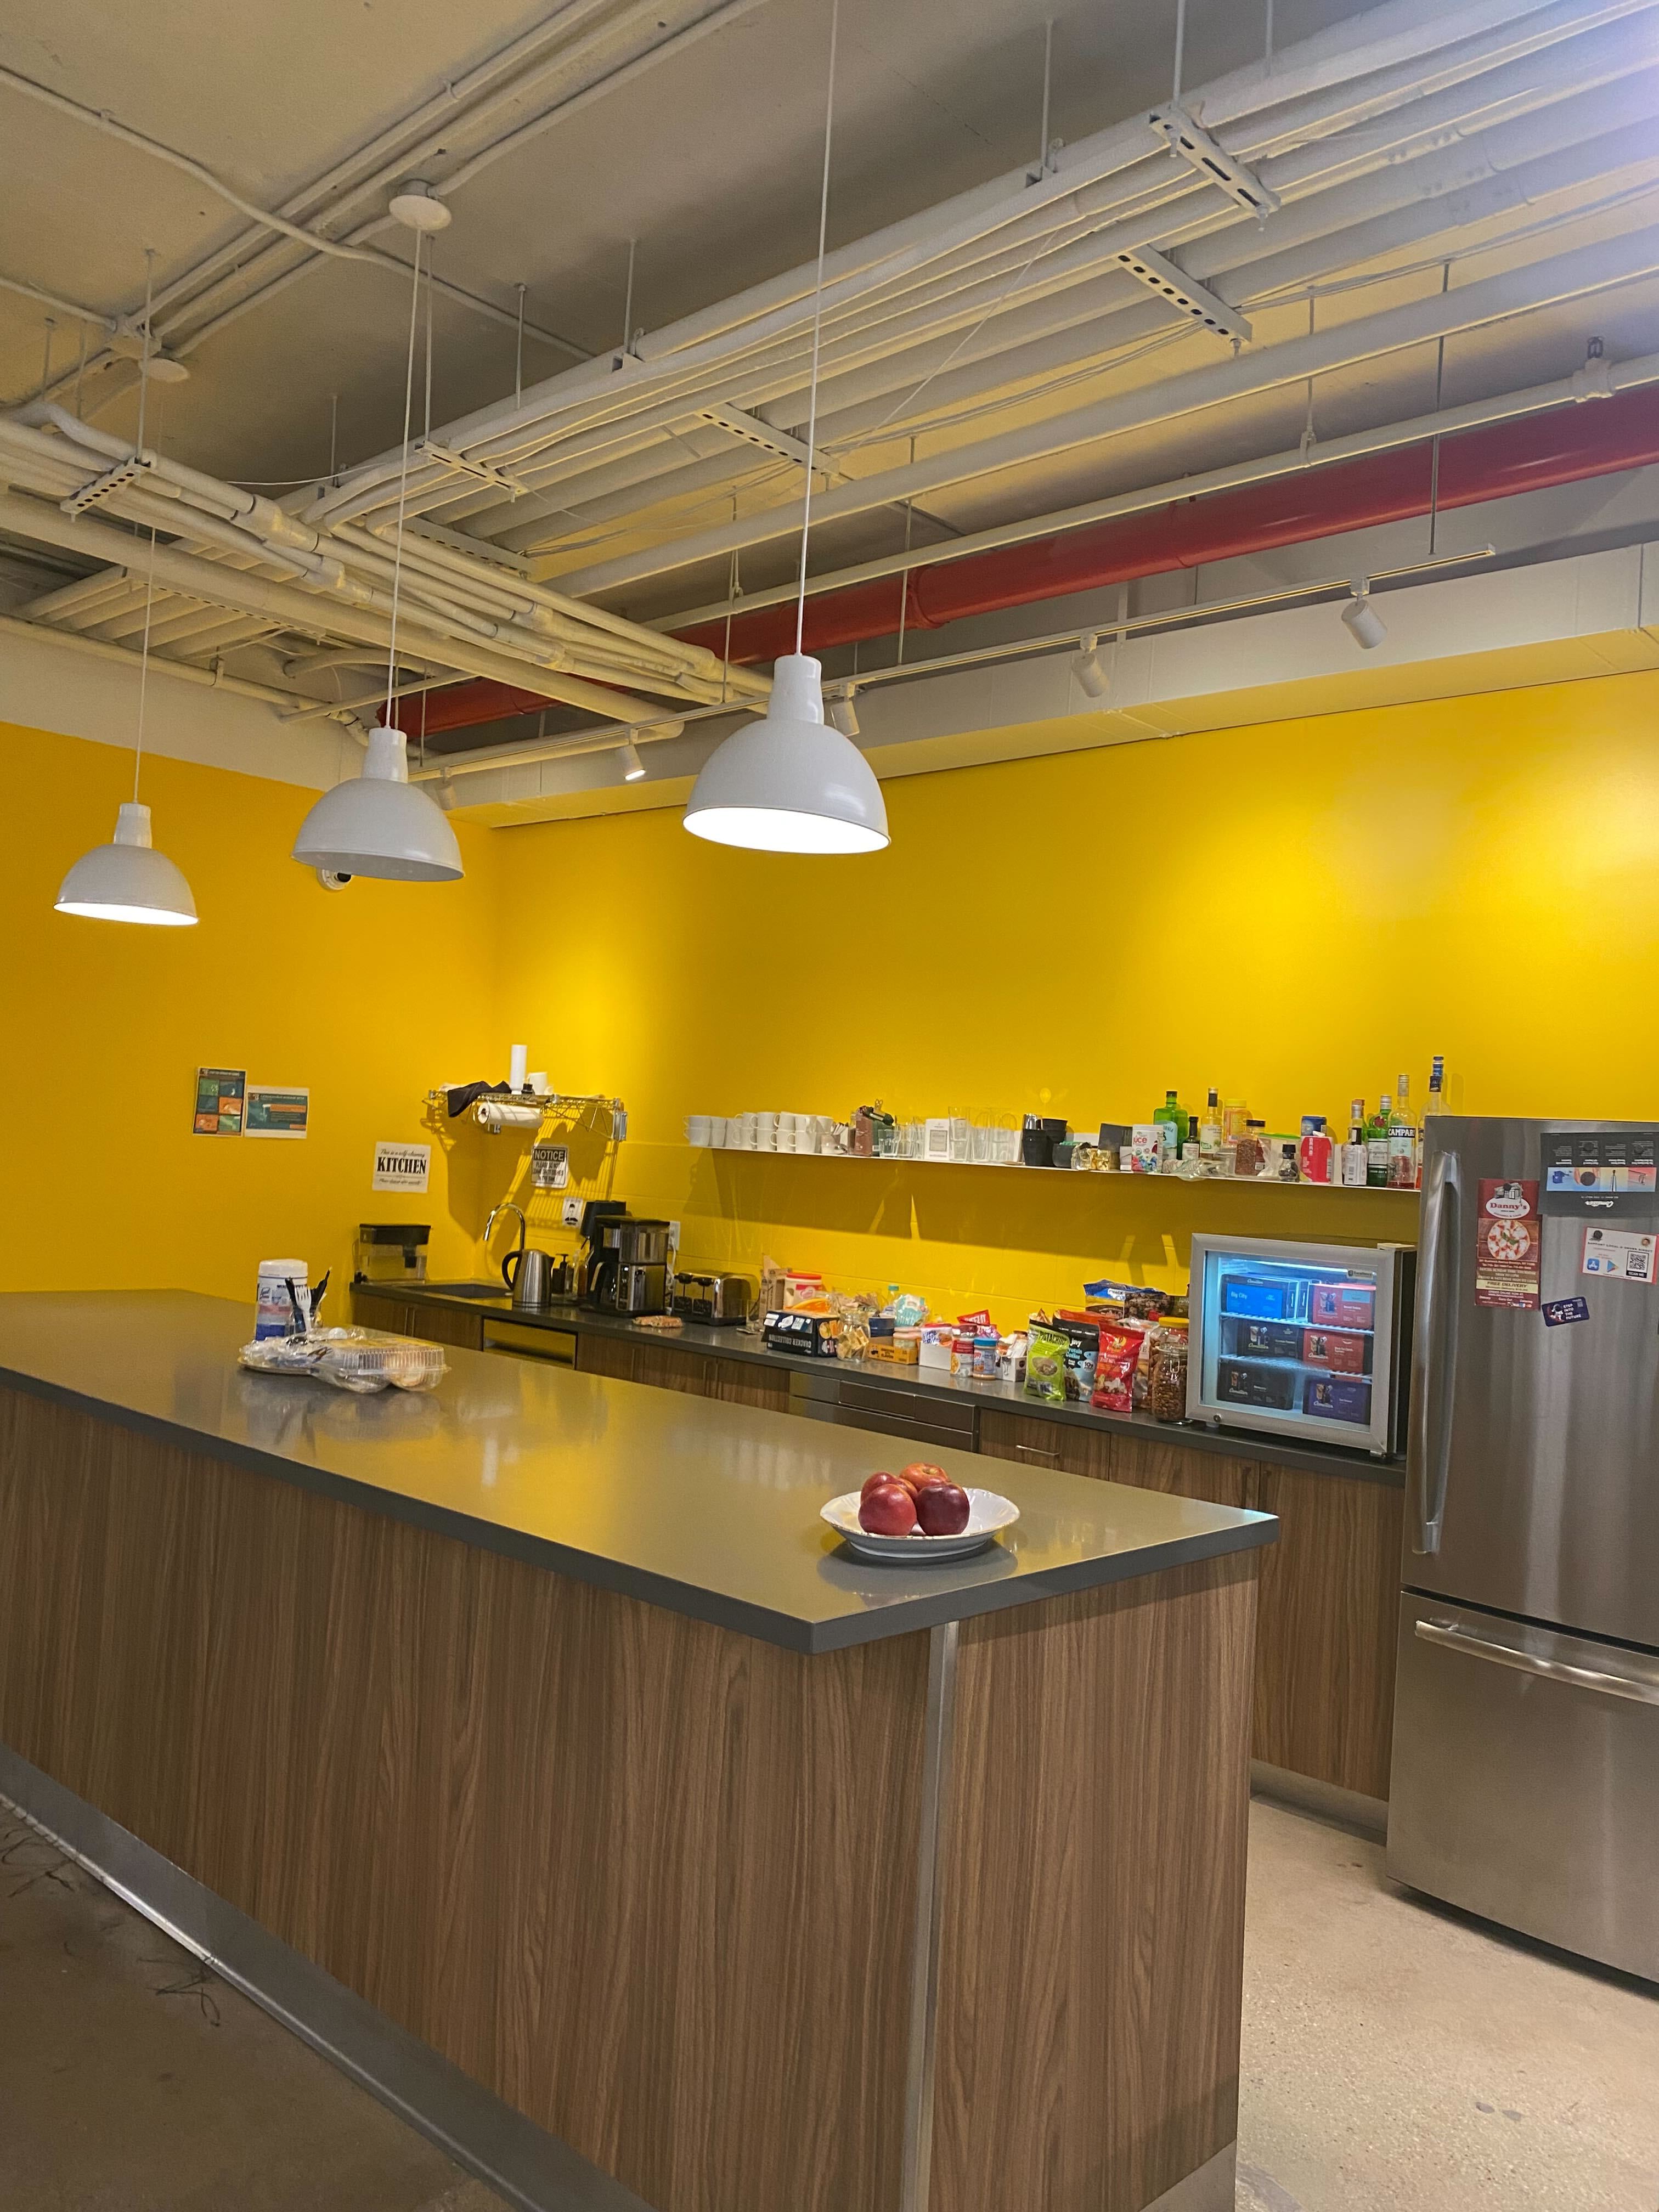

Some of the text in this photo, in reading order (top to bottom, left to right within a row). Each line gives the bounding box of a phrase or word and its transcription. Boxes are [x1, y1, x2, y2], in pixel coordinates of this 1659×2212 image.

[1388, 1128, 1415, 1137] CAMPARI
[534, 1150, 564, 1161] NOTICE
[377, 1156, 426, 1175] KITCHEN
[1489, 1202, 1527, 1210] Danny's
[768, 1334, 812, 1348] CRACKER COLLECTION
